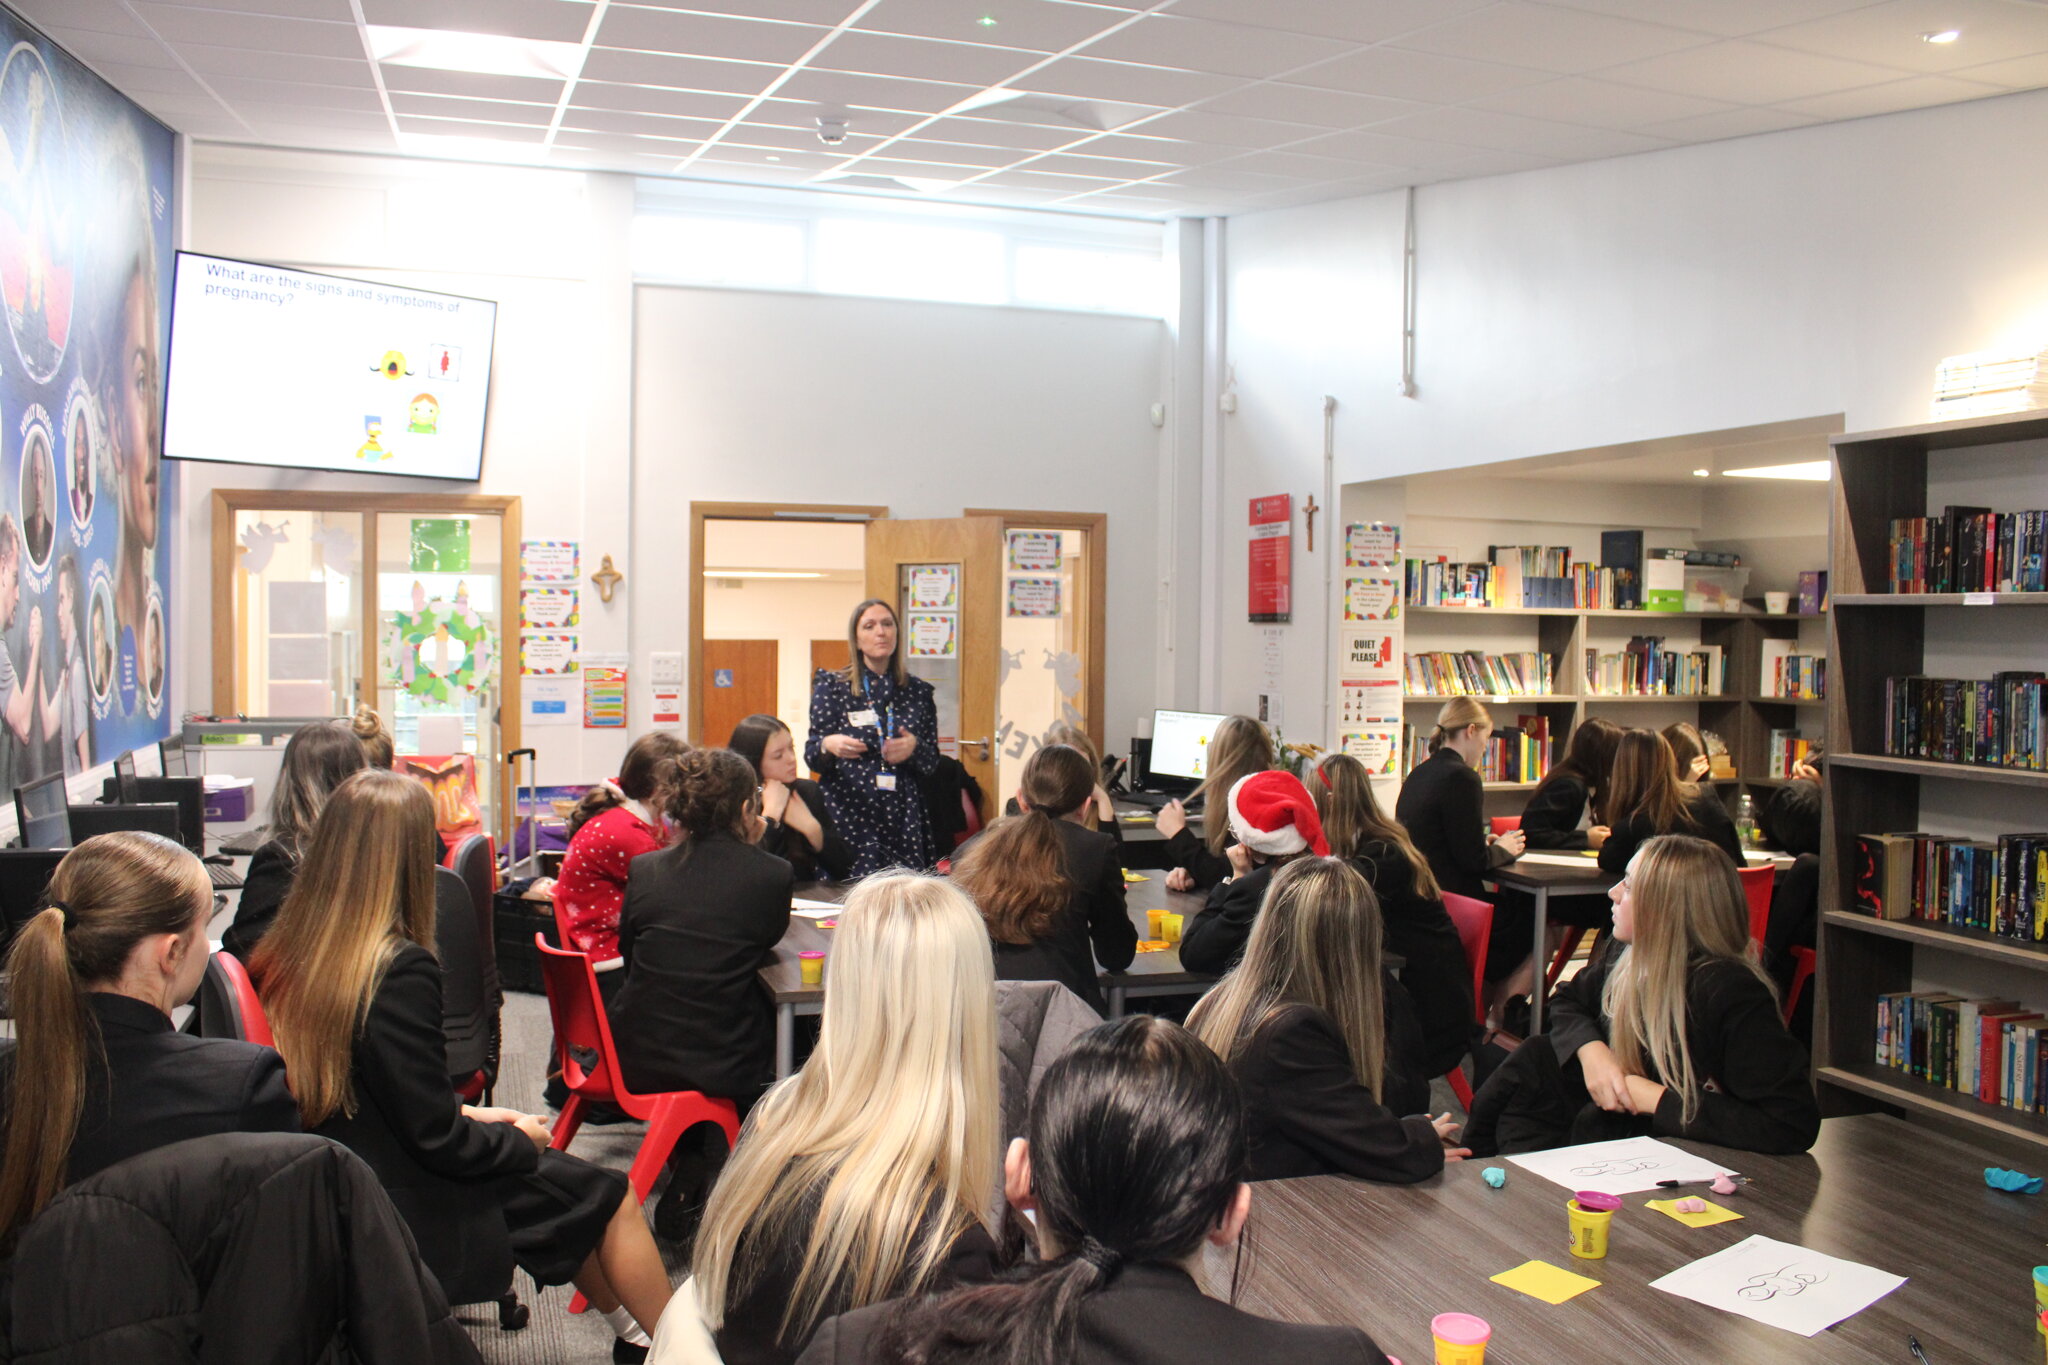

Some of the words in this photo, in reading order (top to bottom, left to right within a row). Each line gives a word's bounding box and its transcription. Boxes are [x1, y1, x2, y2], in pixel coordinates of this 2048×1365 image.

[204, 281, 294, 307] pregnancy?
[206, 263, 245, 281] What
[250, 273, 274, 285] are
[278, 275, 301, 289] the
[305, 281, 343, 296] signs
[347, 286, 373, 301] and
[376, 290, 444, 312] symptoms
[447, 302, 461, 313] of
[1354, 640, 1376, 649] QUIET
[1351, 653, 1377, 662] PLEASE
